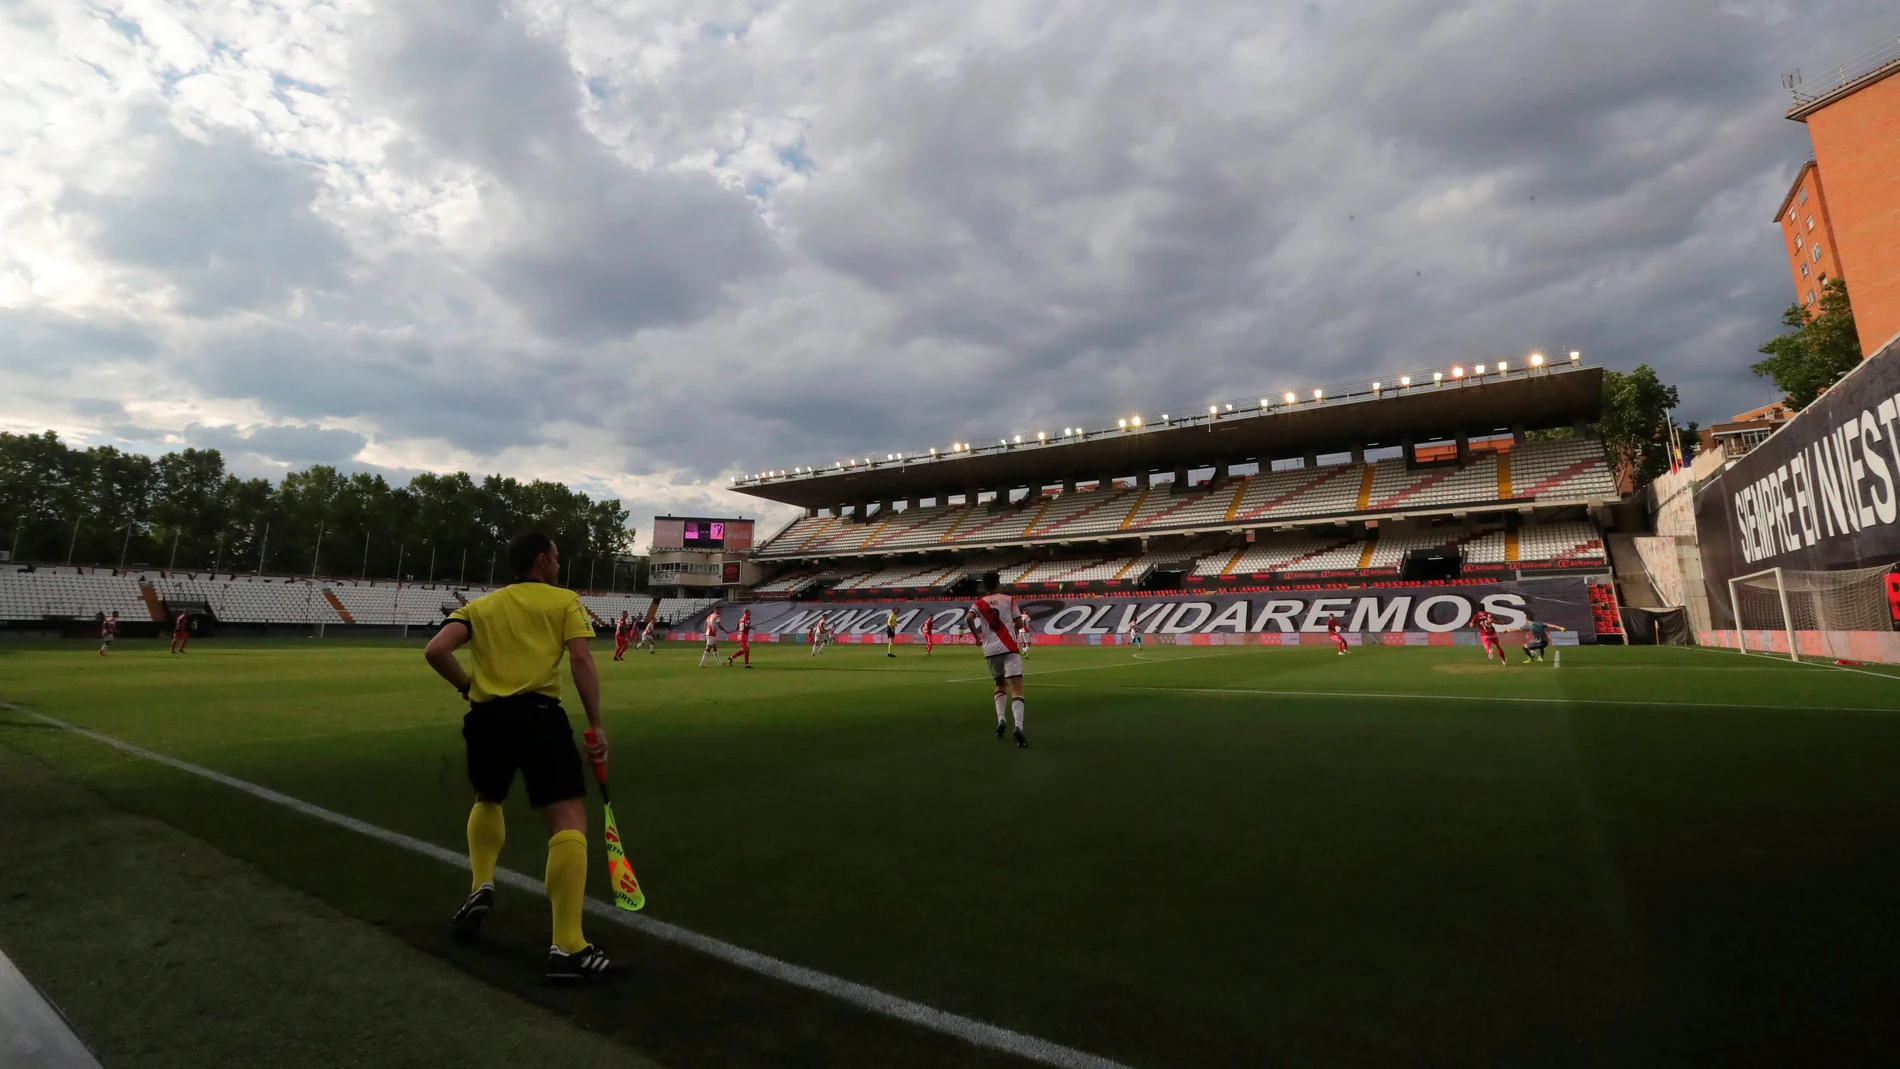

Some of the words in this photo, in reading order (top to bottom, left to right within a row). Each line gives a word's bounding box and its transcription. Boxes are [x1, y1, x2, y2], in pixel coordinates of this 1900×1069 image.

[1735, 465, 1801, 564] SIEMPRE
[1790, 447, 1821, 546] EN
[1813, 393, 1900, 537] NUEST
[769, 608, 920, 634] NUNCA
[1044, 593, 1527, 634] OLVIDAREMOS
[607, 844, 623, 856] RTH
